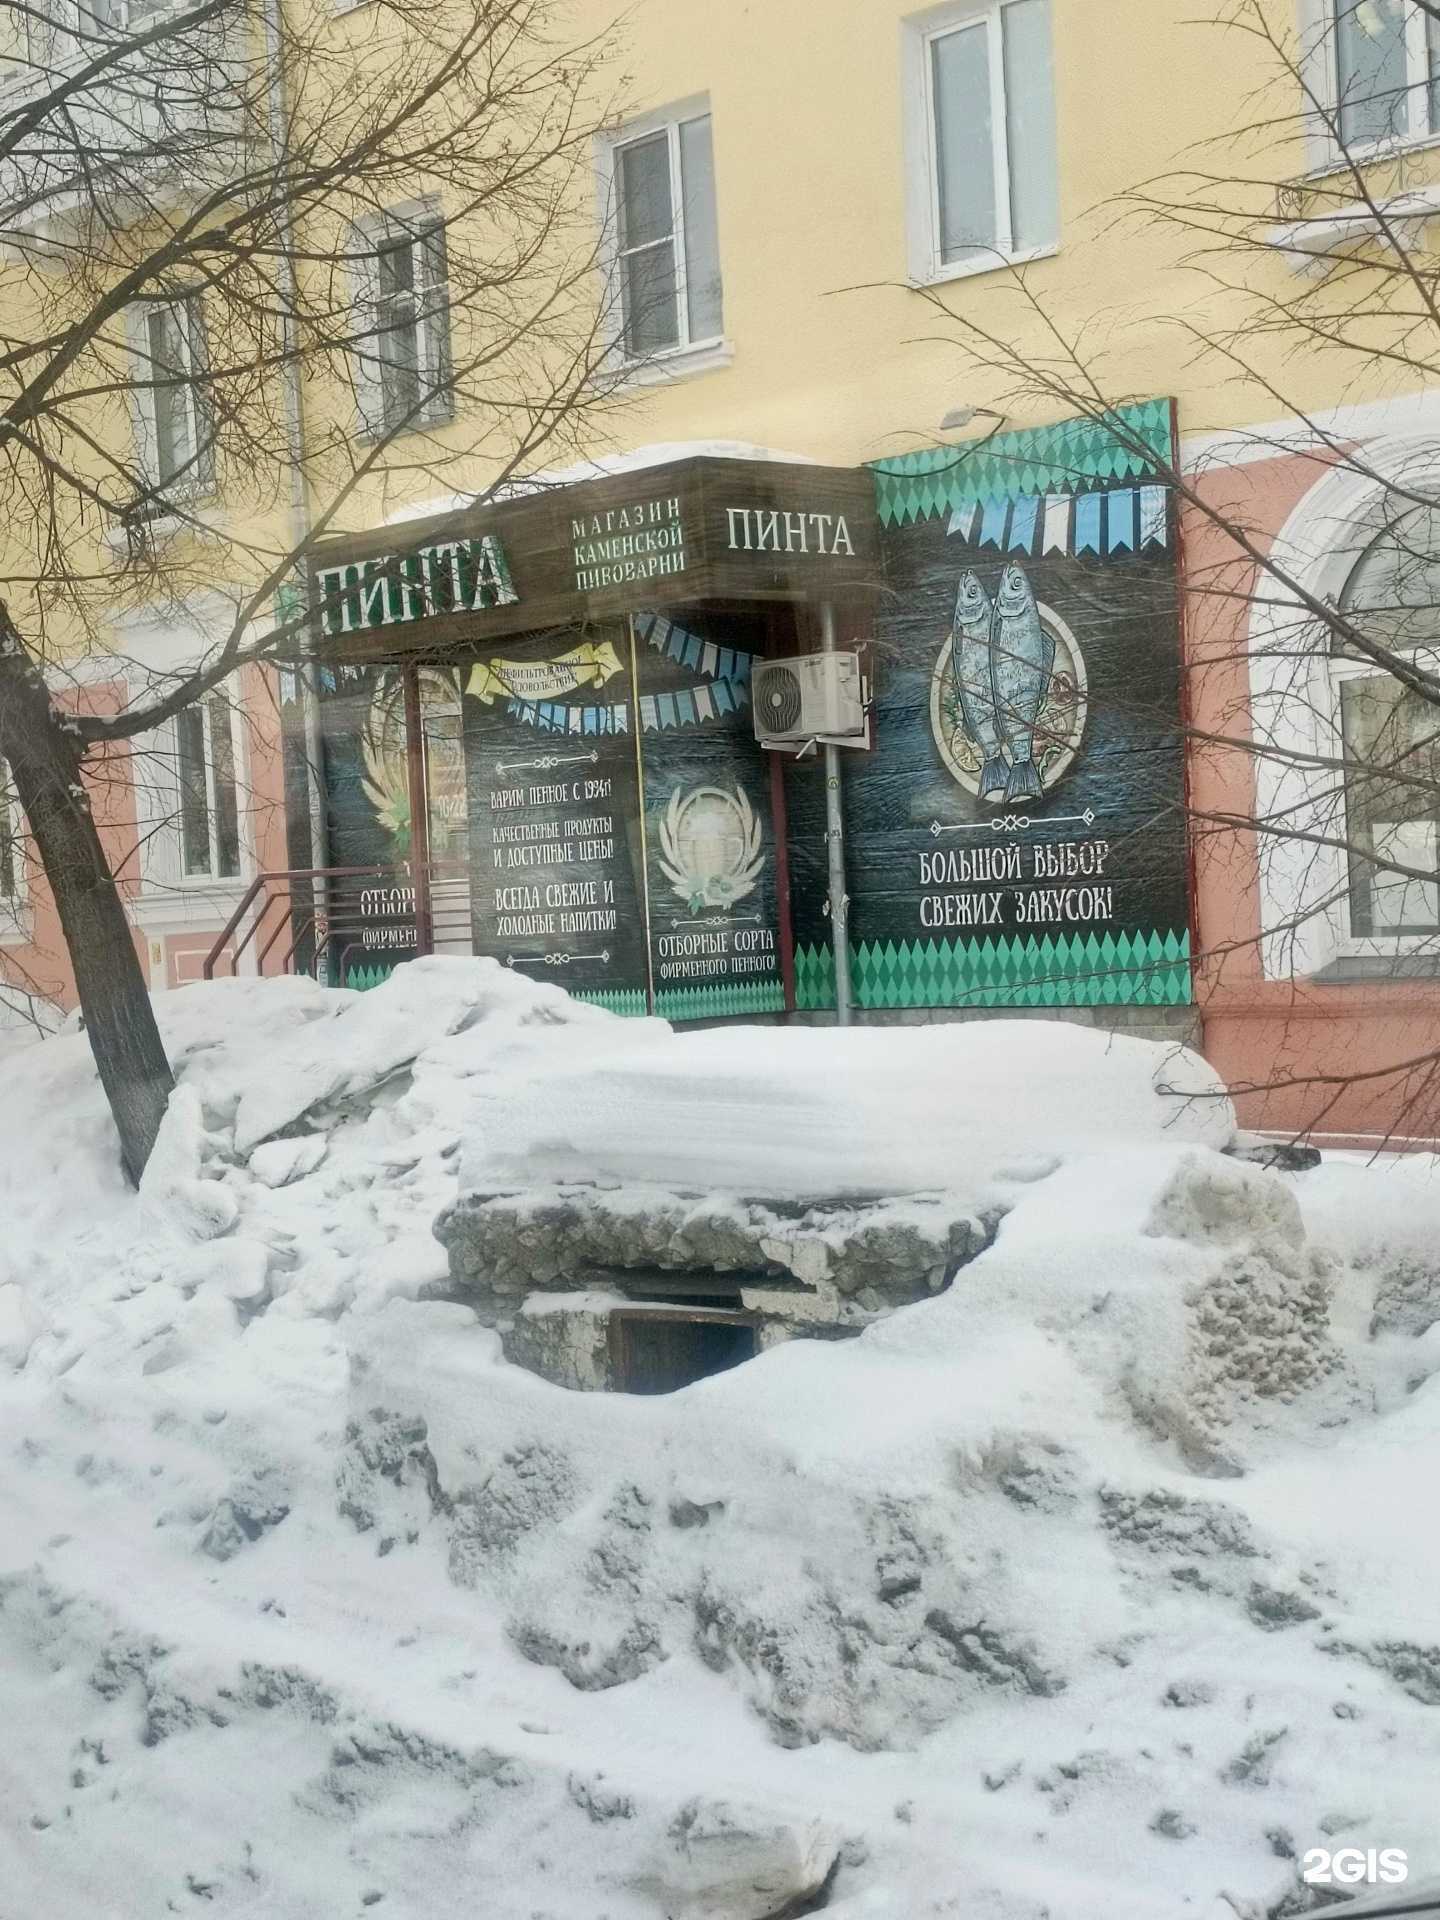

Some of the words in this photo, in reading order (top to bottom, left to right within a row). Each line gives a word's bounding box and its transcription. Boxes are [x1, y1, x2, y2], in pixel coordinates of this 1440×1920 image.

[572, 498, 680, 540] МАГАЗИН
[726, 508, 855, 556] ПИНТА
[574, 521, 683, 566] КАМЕНСКОЙ
[315, 535, 519, 636] ПИНТА
[575, 551, 685, 591] ПИВОВАРНИ
[491, 788, 525, 809] ВАРИМ
[529, 783, 569, 806] ПЕННОЕ
[573, 782, 581, 800] С
[492, 821, 560, 844] КАЧЕСТВЕННЫЕ
[564, 816, 613, 837] ПРОДУКТЫ
[493, 848, 502, 868] И
[507, 842, 575, 869] ДОСТУПНЫЕ
[919, 842, 1022, 884] БОЛЬШОЙ
[1033, 840, 1110, 878] ВЫБОР
[495, 886, 540, 912] ВСЕГДА
[546, 881, 597, 907] СВЕЖИЕ
[604, 880, 614, 904] И
[919, 892, 1004, 927] СВЕЖИХ
[1014, 886, 1113, 923] ЗАКУСОК!
[496, 914, 556, 936] ХОЛОДНЫЕ
[560, 909, 616, 933] НАПИТКИ!
[658, 932, 728, 957] ОТБОРНЫЕ
[734, 929, 774, 952] СОРТА
[660, 958, 727, 979] ФИРМЕННОГО
